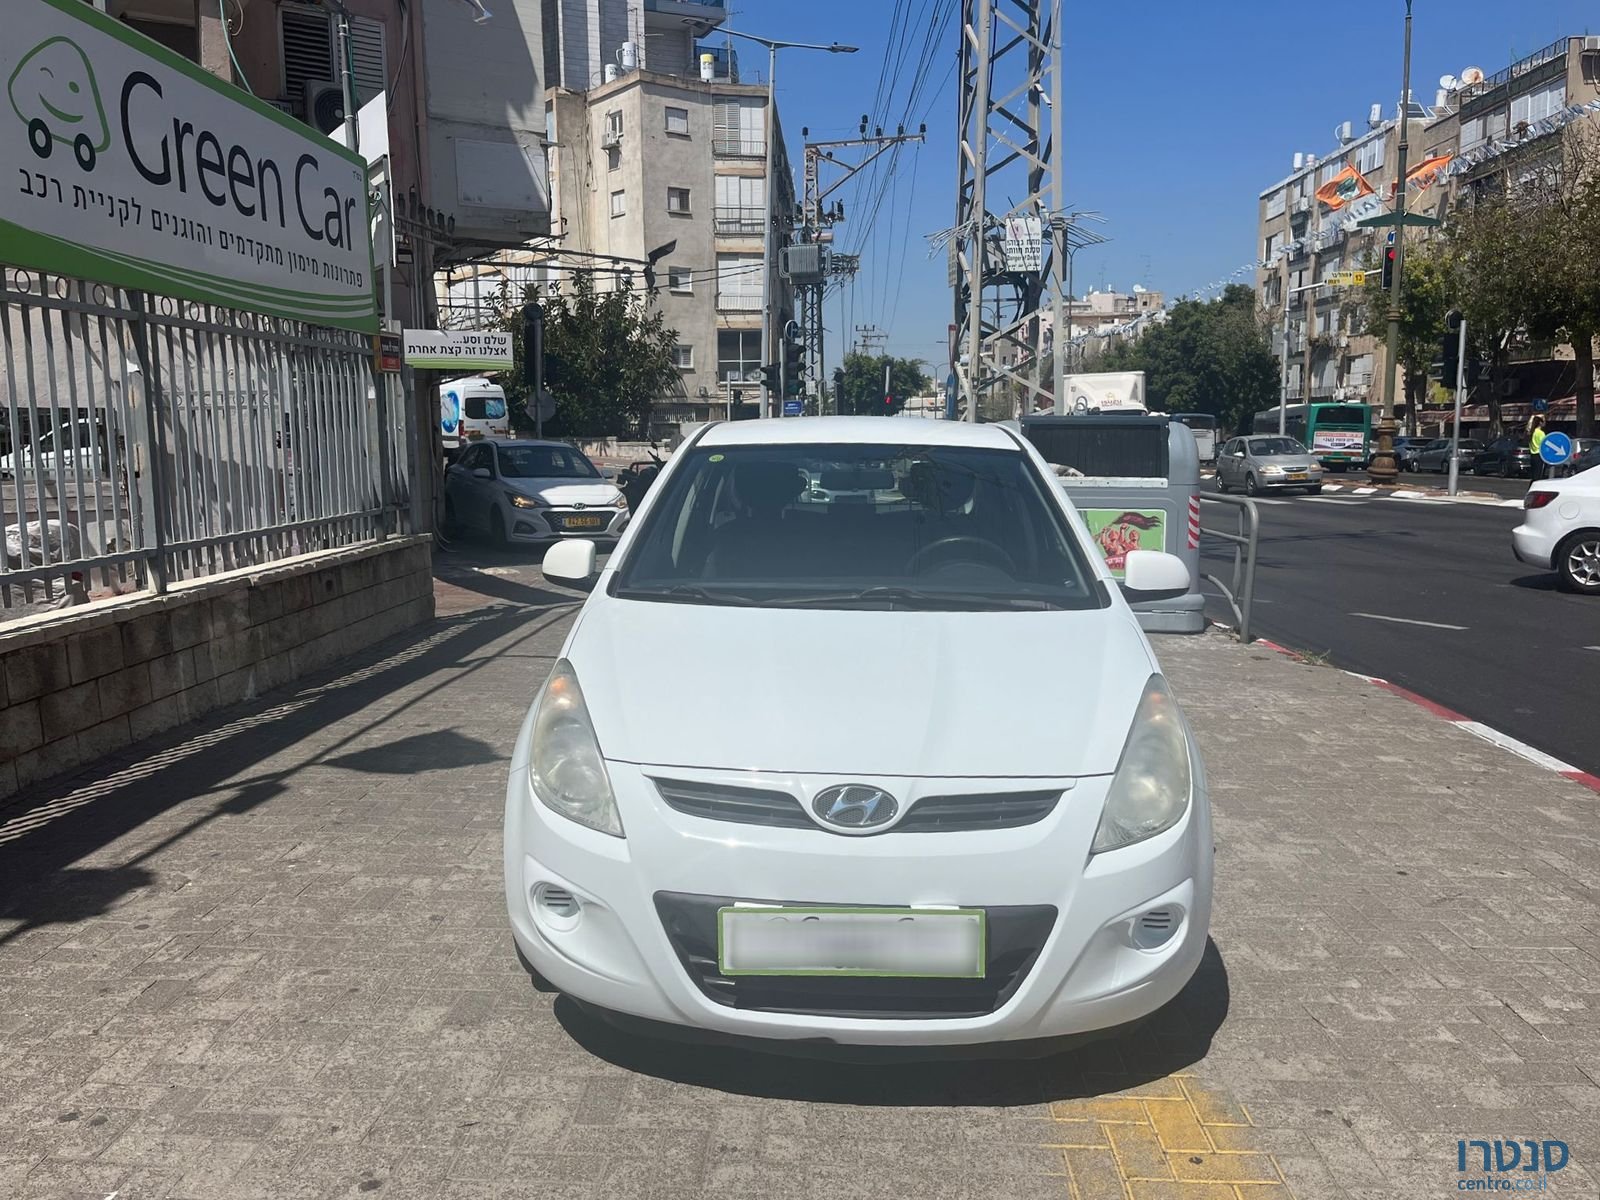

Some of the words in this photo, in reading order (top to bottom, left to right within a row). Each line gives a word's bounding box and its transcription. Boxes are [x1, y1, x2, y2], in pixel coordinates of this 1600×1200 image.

[120, 71, 286, 229] Green
[295, 153, 356, 252] Car
[19, 168, 63, 203] רכב
[73, 184, 142, 228] לקניית
[151, 209, 213, 246] והוגנים
[219, 230, 284, 265] מתקדמים
[287, 251, 319, 275] מימון
[323, 262, 363, 288] פתרונות
[408, 345, 437, 354] אחרת
[440, 345, 462, 357] קצת
[452, 336, 481, 345] וסע...
[465, 346, 476, 355] זה
[479, 345, 507, 356] אצלנו
[484, 335, 507, 345] שלם
